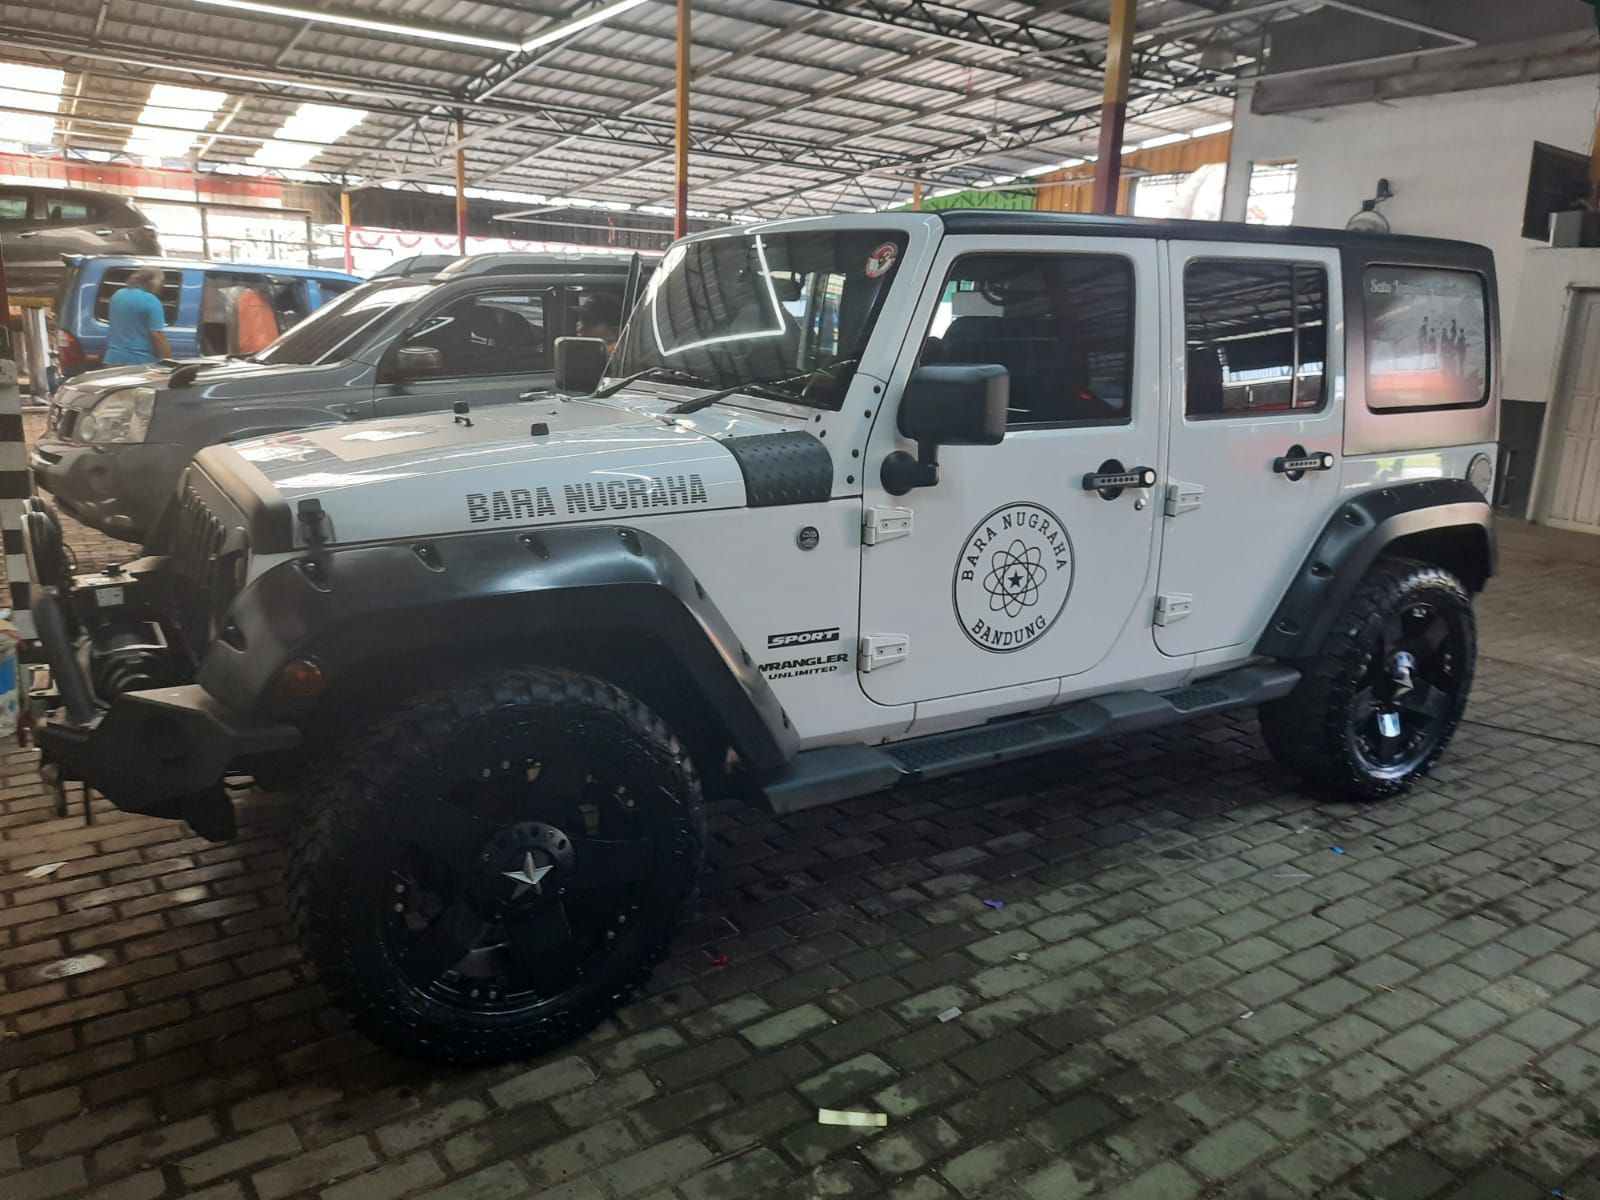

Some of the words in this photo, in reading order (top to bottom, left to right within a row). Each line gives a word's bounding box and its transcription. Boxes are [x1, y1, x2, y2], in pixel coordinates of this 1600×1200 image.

[466, 487, 556, 523] BARA
[564, 474, 708, 514] NUGRAHA
[961, 527, 997, 581] BARA
[1002, 512, 1067, 571] NUGRAHA
[768, 629, 840, 648] SPORT
[972, 616, 1046, 646] BANDUNG
[768, 665, 837, 680] UNLIMITED
